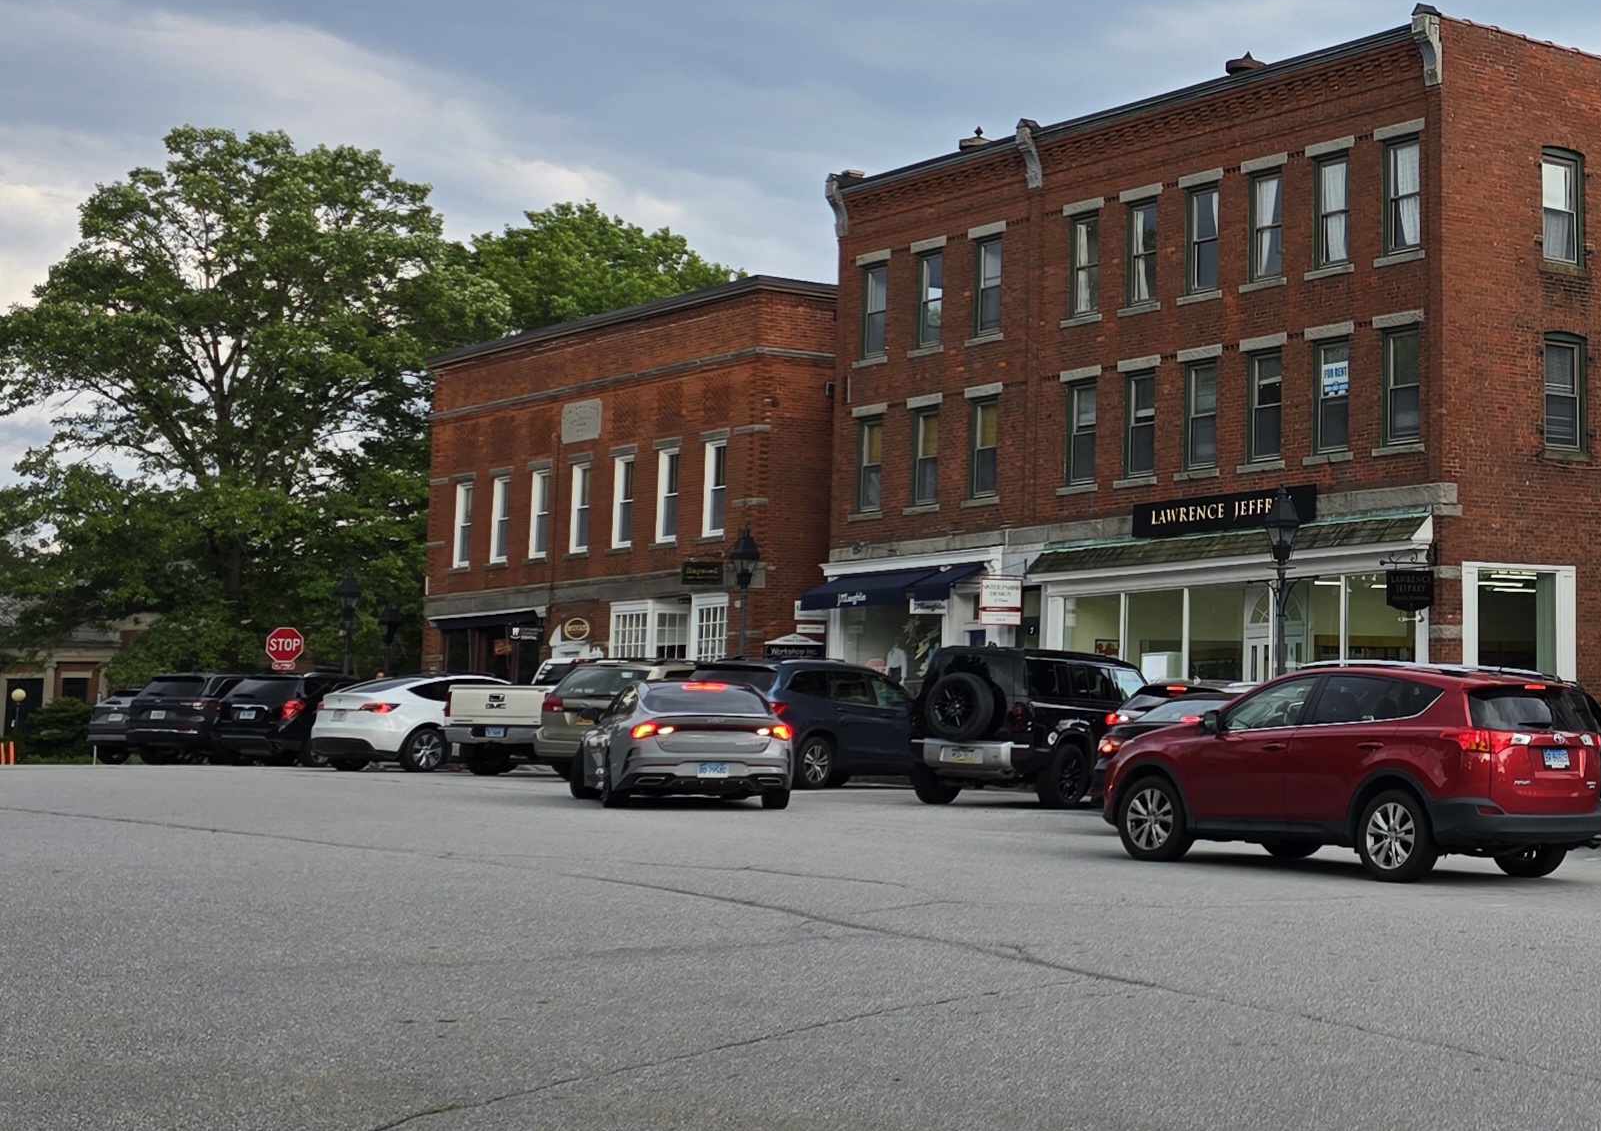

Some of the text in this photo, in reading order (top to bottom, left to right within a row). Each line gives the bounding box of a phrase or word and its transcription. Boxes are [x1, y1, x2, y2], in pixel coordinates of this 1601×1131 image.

[1324, 367, 1347, 379] FOR RENT
[1151, 495, 1292, 525] LAWRENCE JEFFR
[269, 638, 301, 652] STOP
